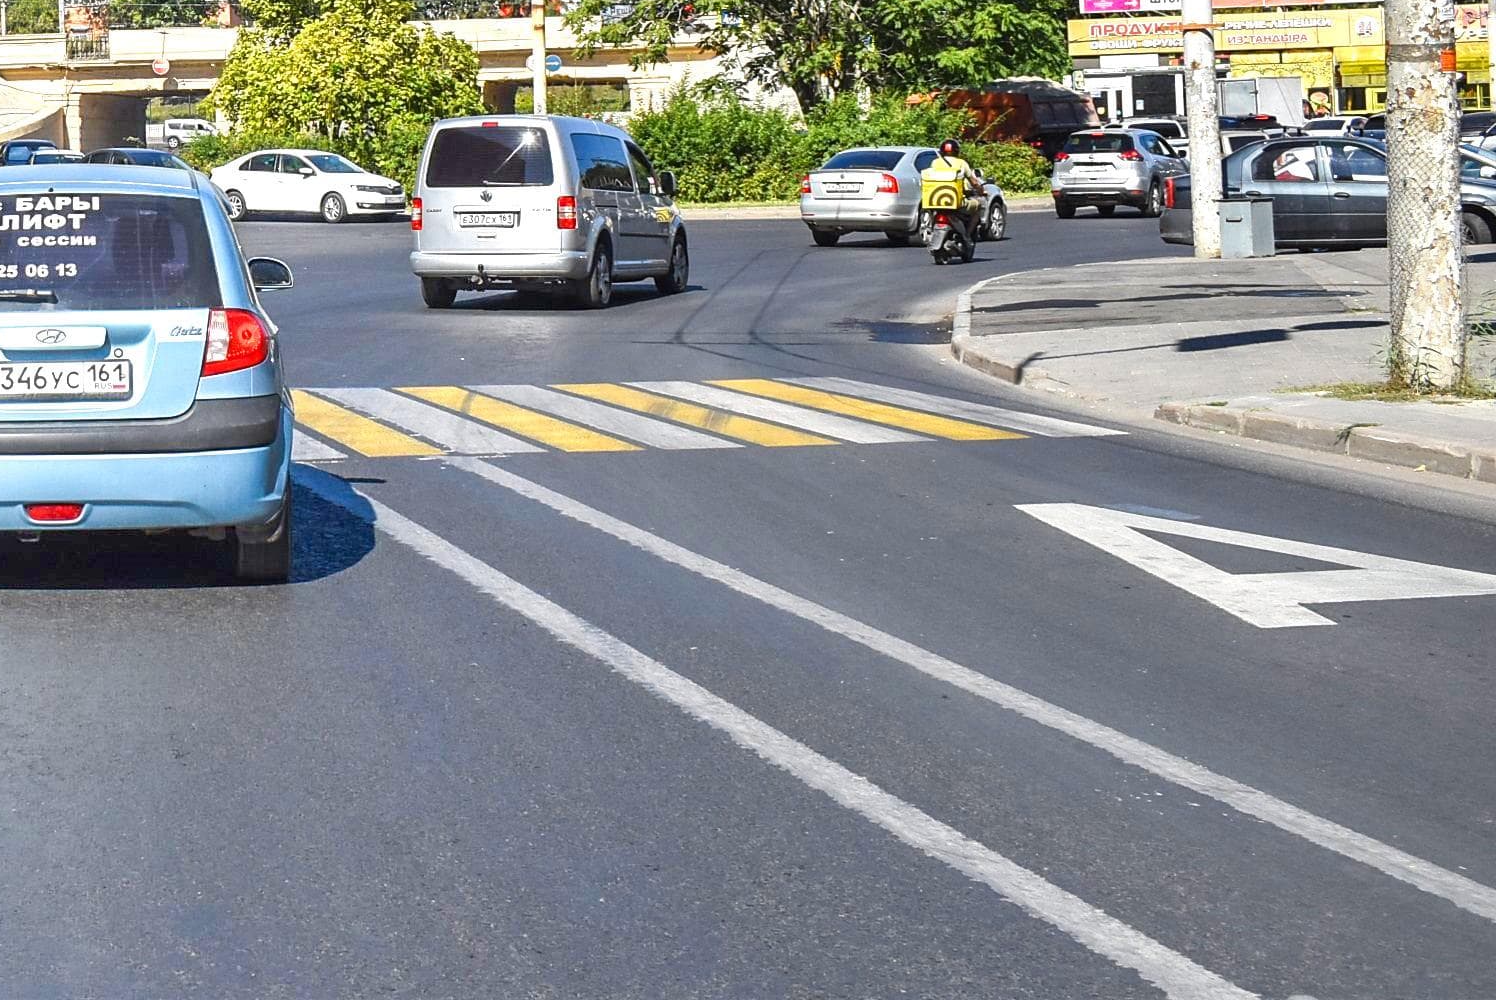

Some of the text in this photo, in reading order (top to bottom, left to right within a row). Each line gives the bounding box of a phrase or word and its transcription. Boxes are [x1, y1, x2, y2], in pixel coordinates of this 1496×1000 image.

[15, 196, 100, 212] БАРЫ
[17, 234, 97, 248] сессии
[25, 264, 49, 278] 06
[55, 262, 77, 277] 13
[87, 364, 126, 382] 161
